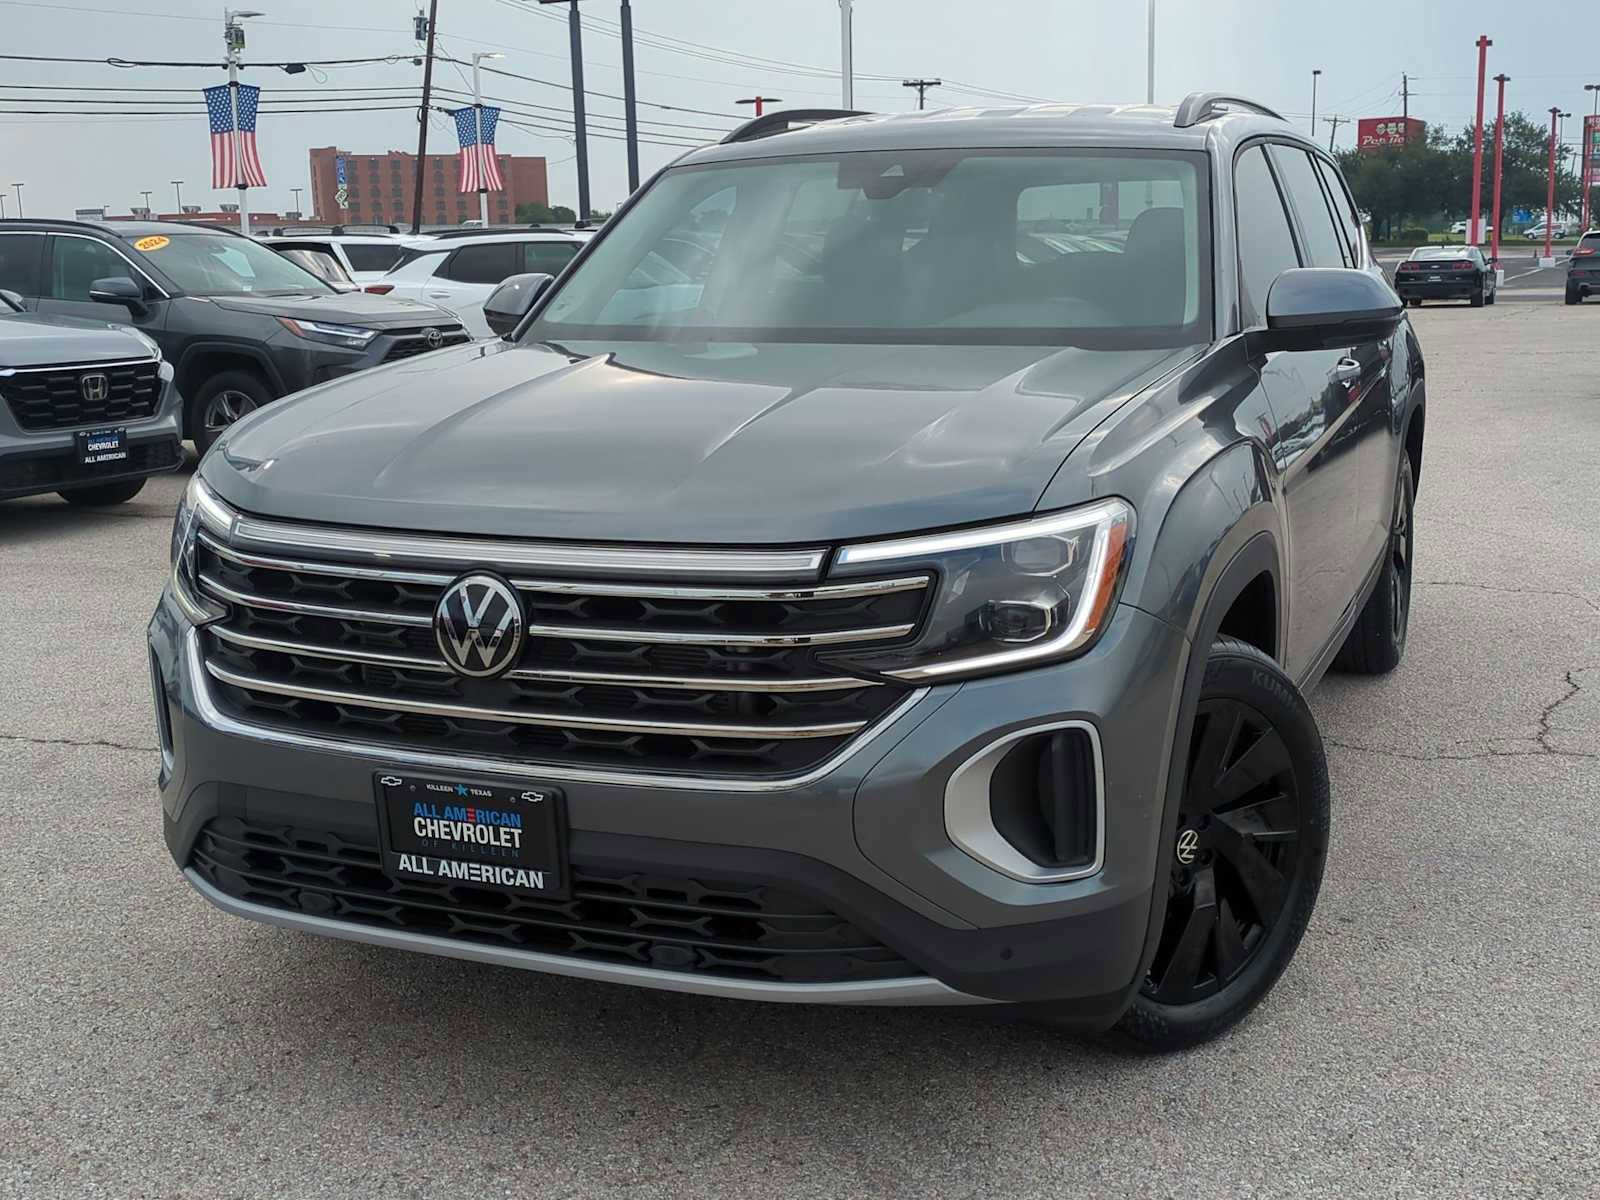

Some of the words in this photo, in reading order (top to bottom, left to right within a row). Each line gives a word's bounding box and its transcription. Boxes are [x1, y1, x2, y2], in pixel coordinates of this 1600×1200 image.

[138, 237, 167, 249] 2024
[88, 441, 119, 451] CHEVROLET
[84, 456, 96, 464] ALL
[426, 784, 454, 793] KILLEEN
[470, 789, 492, 797] TEXAS
[413, 802, 440, 819] ALL
[444, 805, 521, 827] AMERICAN
[413, 817, 523, 849] CHEVROLET
[398, 854, 434, 876] ALL
[438, 860, 544, 889] AMERICAN
